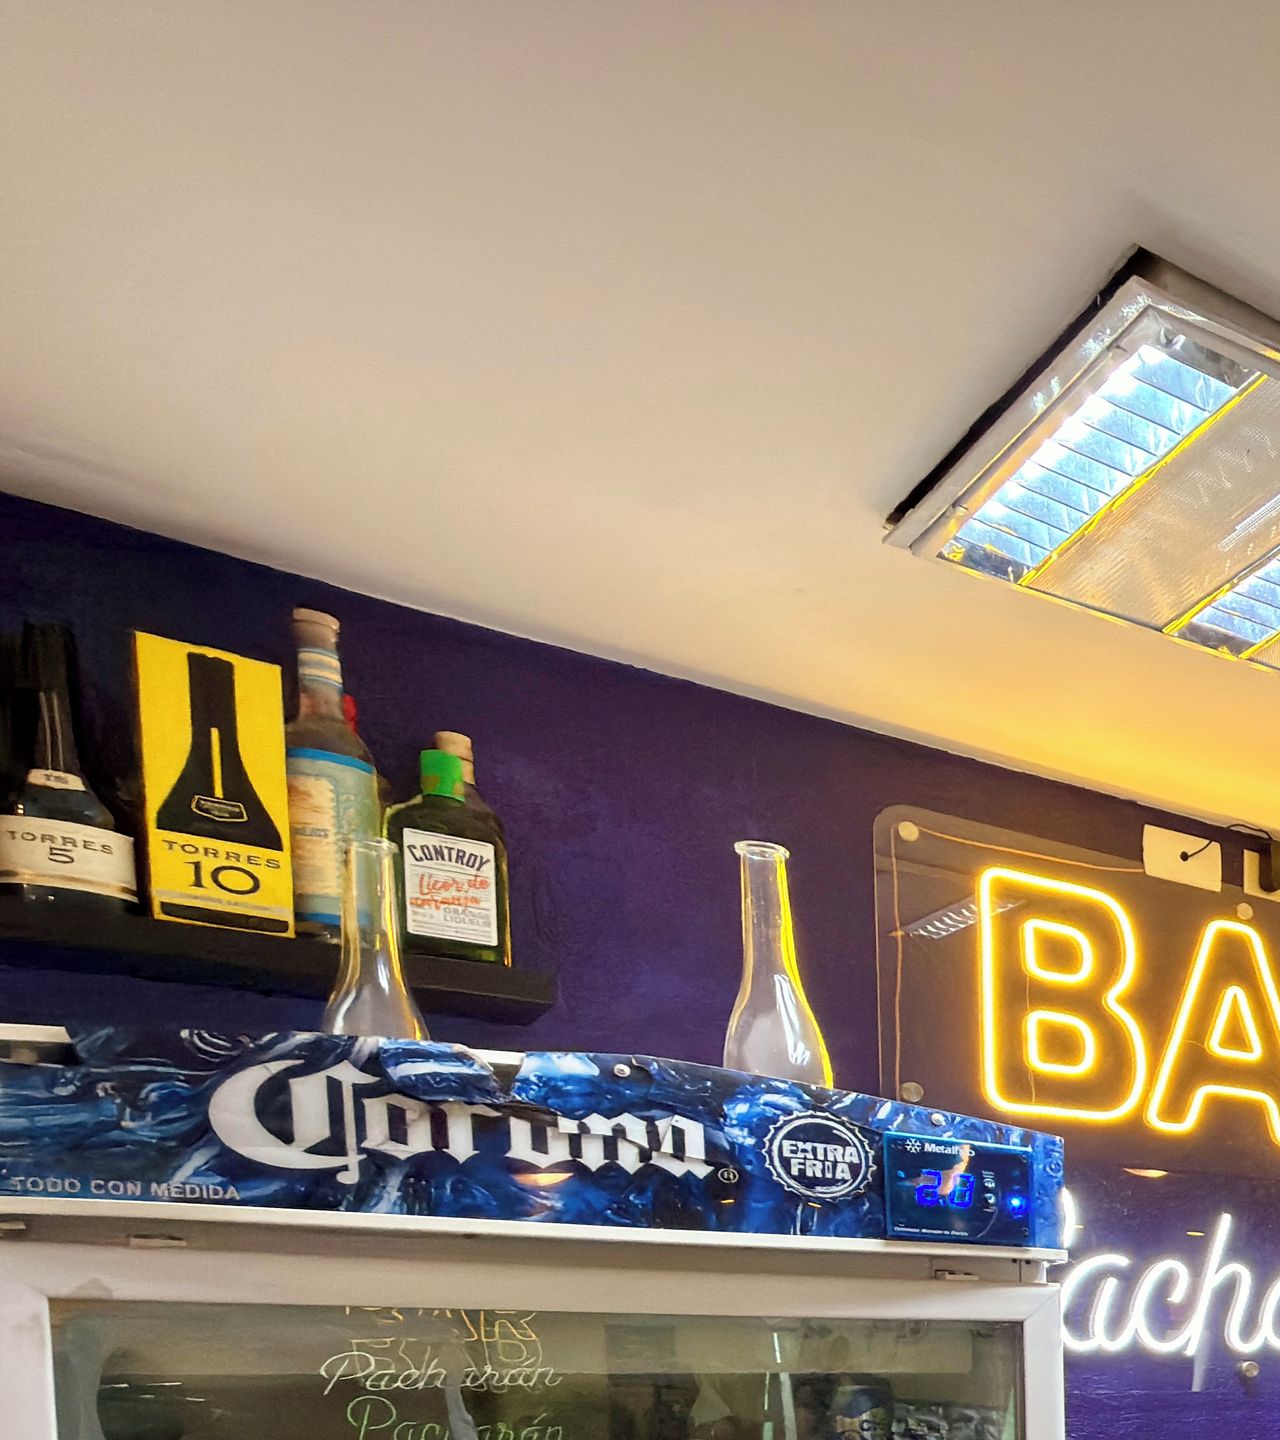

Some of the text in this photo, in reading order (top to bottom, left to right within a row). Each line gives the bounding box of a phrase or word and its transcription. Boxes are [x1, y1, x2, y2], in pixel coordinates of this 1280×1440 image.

[7, 829, 114, 855] TORRES
[161, 839, 281, 869] TORRES
[47, 847, 75, 865] 5
[406, 844, 491, 871] CONTROY
[184, 860, 261, 895] 10
[208, 1059, 714, 1184] Corona
[781, 1139, 860, 1164] EXTRA
[790, 1158, 852, 1180] FRIA
[10, 1175, 241, 1201] TODO CON MEDIDA
